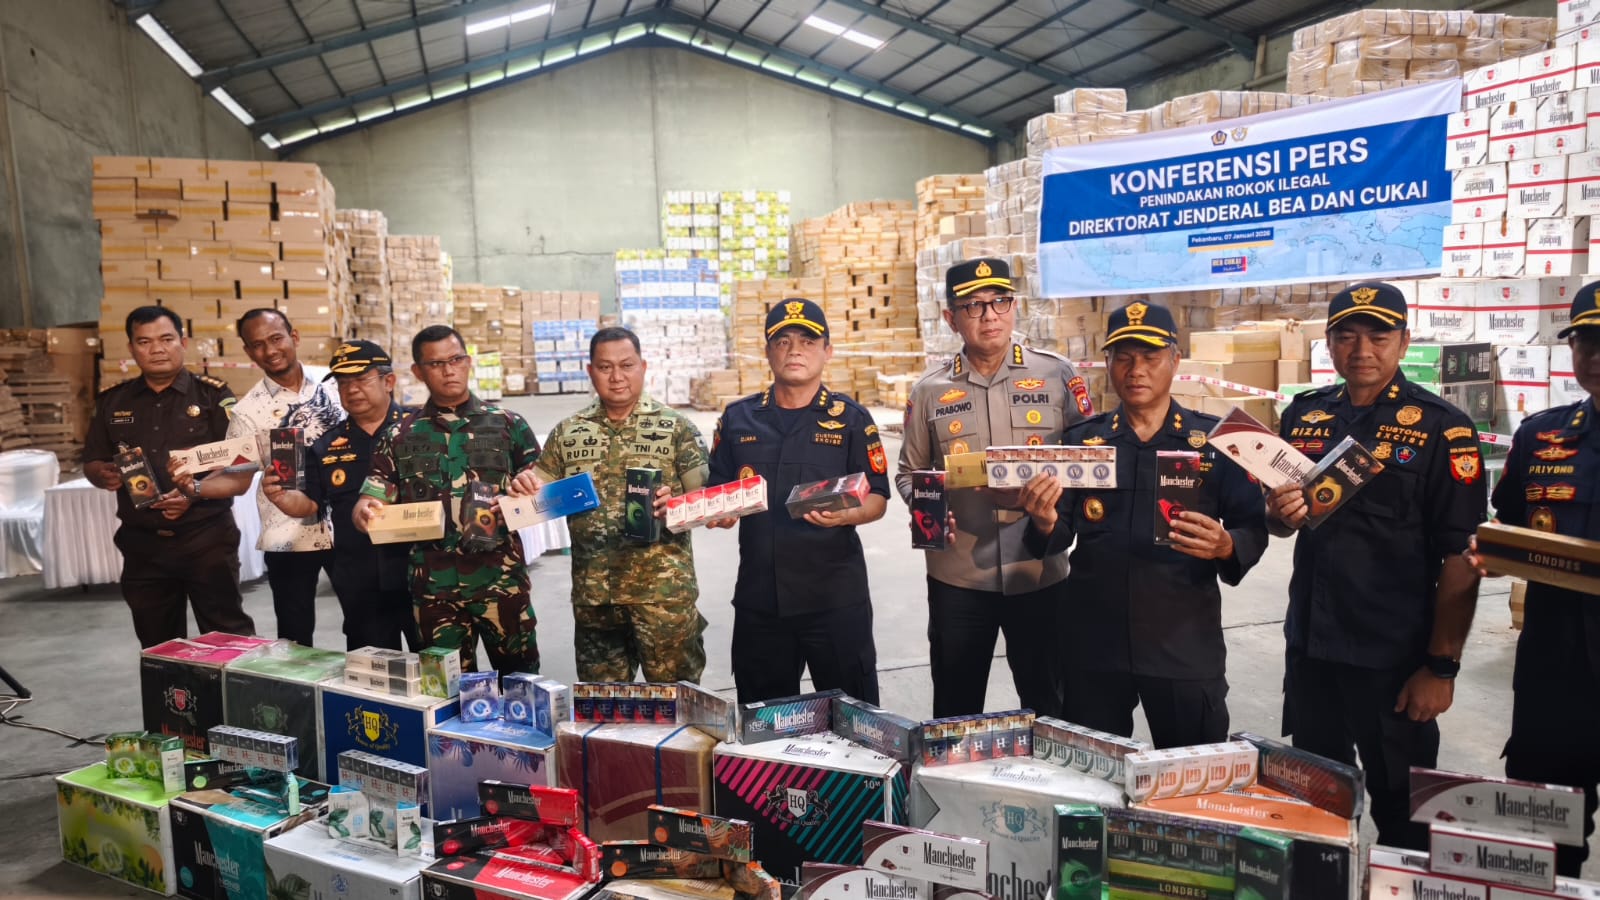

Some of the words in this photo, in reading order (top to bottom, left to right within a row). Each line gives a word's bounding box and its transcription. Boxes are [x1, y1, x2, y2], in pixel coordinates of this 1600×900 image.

[1110, 149, 1280, 196] KONFERENSI
[1289, 136, 1369, 173] PERS
[1139, 187, 1223, 208] PENINDAKAN
[1225, 181, 1275, 199] ROKOK
[1278, 172, 1331, 191] ILEGAL
[1068, 211, 1170, 237] DIREKTORAT
[1173, 203, 1264, 227] JENDERAL
[1268, 197, 1306, 217] BEA
[1310, 191, 1355, 213] DAN
[1360, 180, 1429, 206] CUKAI
[1489, 313, 1525, 330] Manchester
[1012, 393, 1049, 405] POLRI
[935, 401, 972, 417] PRABOWO
[1291, 427, 1331, 438] RIZAL
[1379, 425, 1428, 440] CUSTOMS
[566, 448, 595, 461] RUDI
[634, 444, 652, 454] TNI
[655, 446, 670, 456] AD
[1160, 475, 1196, 487] Manchester
[1528, 552, 1582, 571] LONDRES
[365, 715, 378, 734] HQ
[774, 708, 815, 731] Manchester
[790, 794, 805, 813] HQ
[1196, 797, 1270, 820] Manchester
[1495, 790, 1571, 823] Manchester
[1006, 811, 1023, 826] HQ
[1062, 836, 1099, 850] Manchester
[923, 840, 977, 871] Manchester
[1476, 844, 1549, 876] Manchester
[865, 876, 918, 900] Manchester
[1160, 882, 1208, 899] LONDRES
